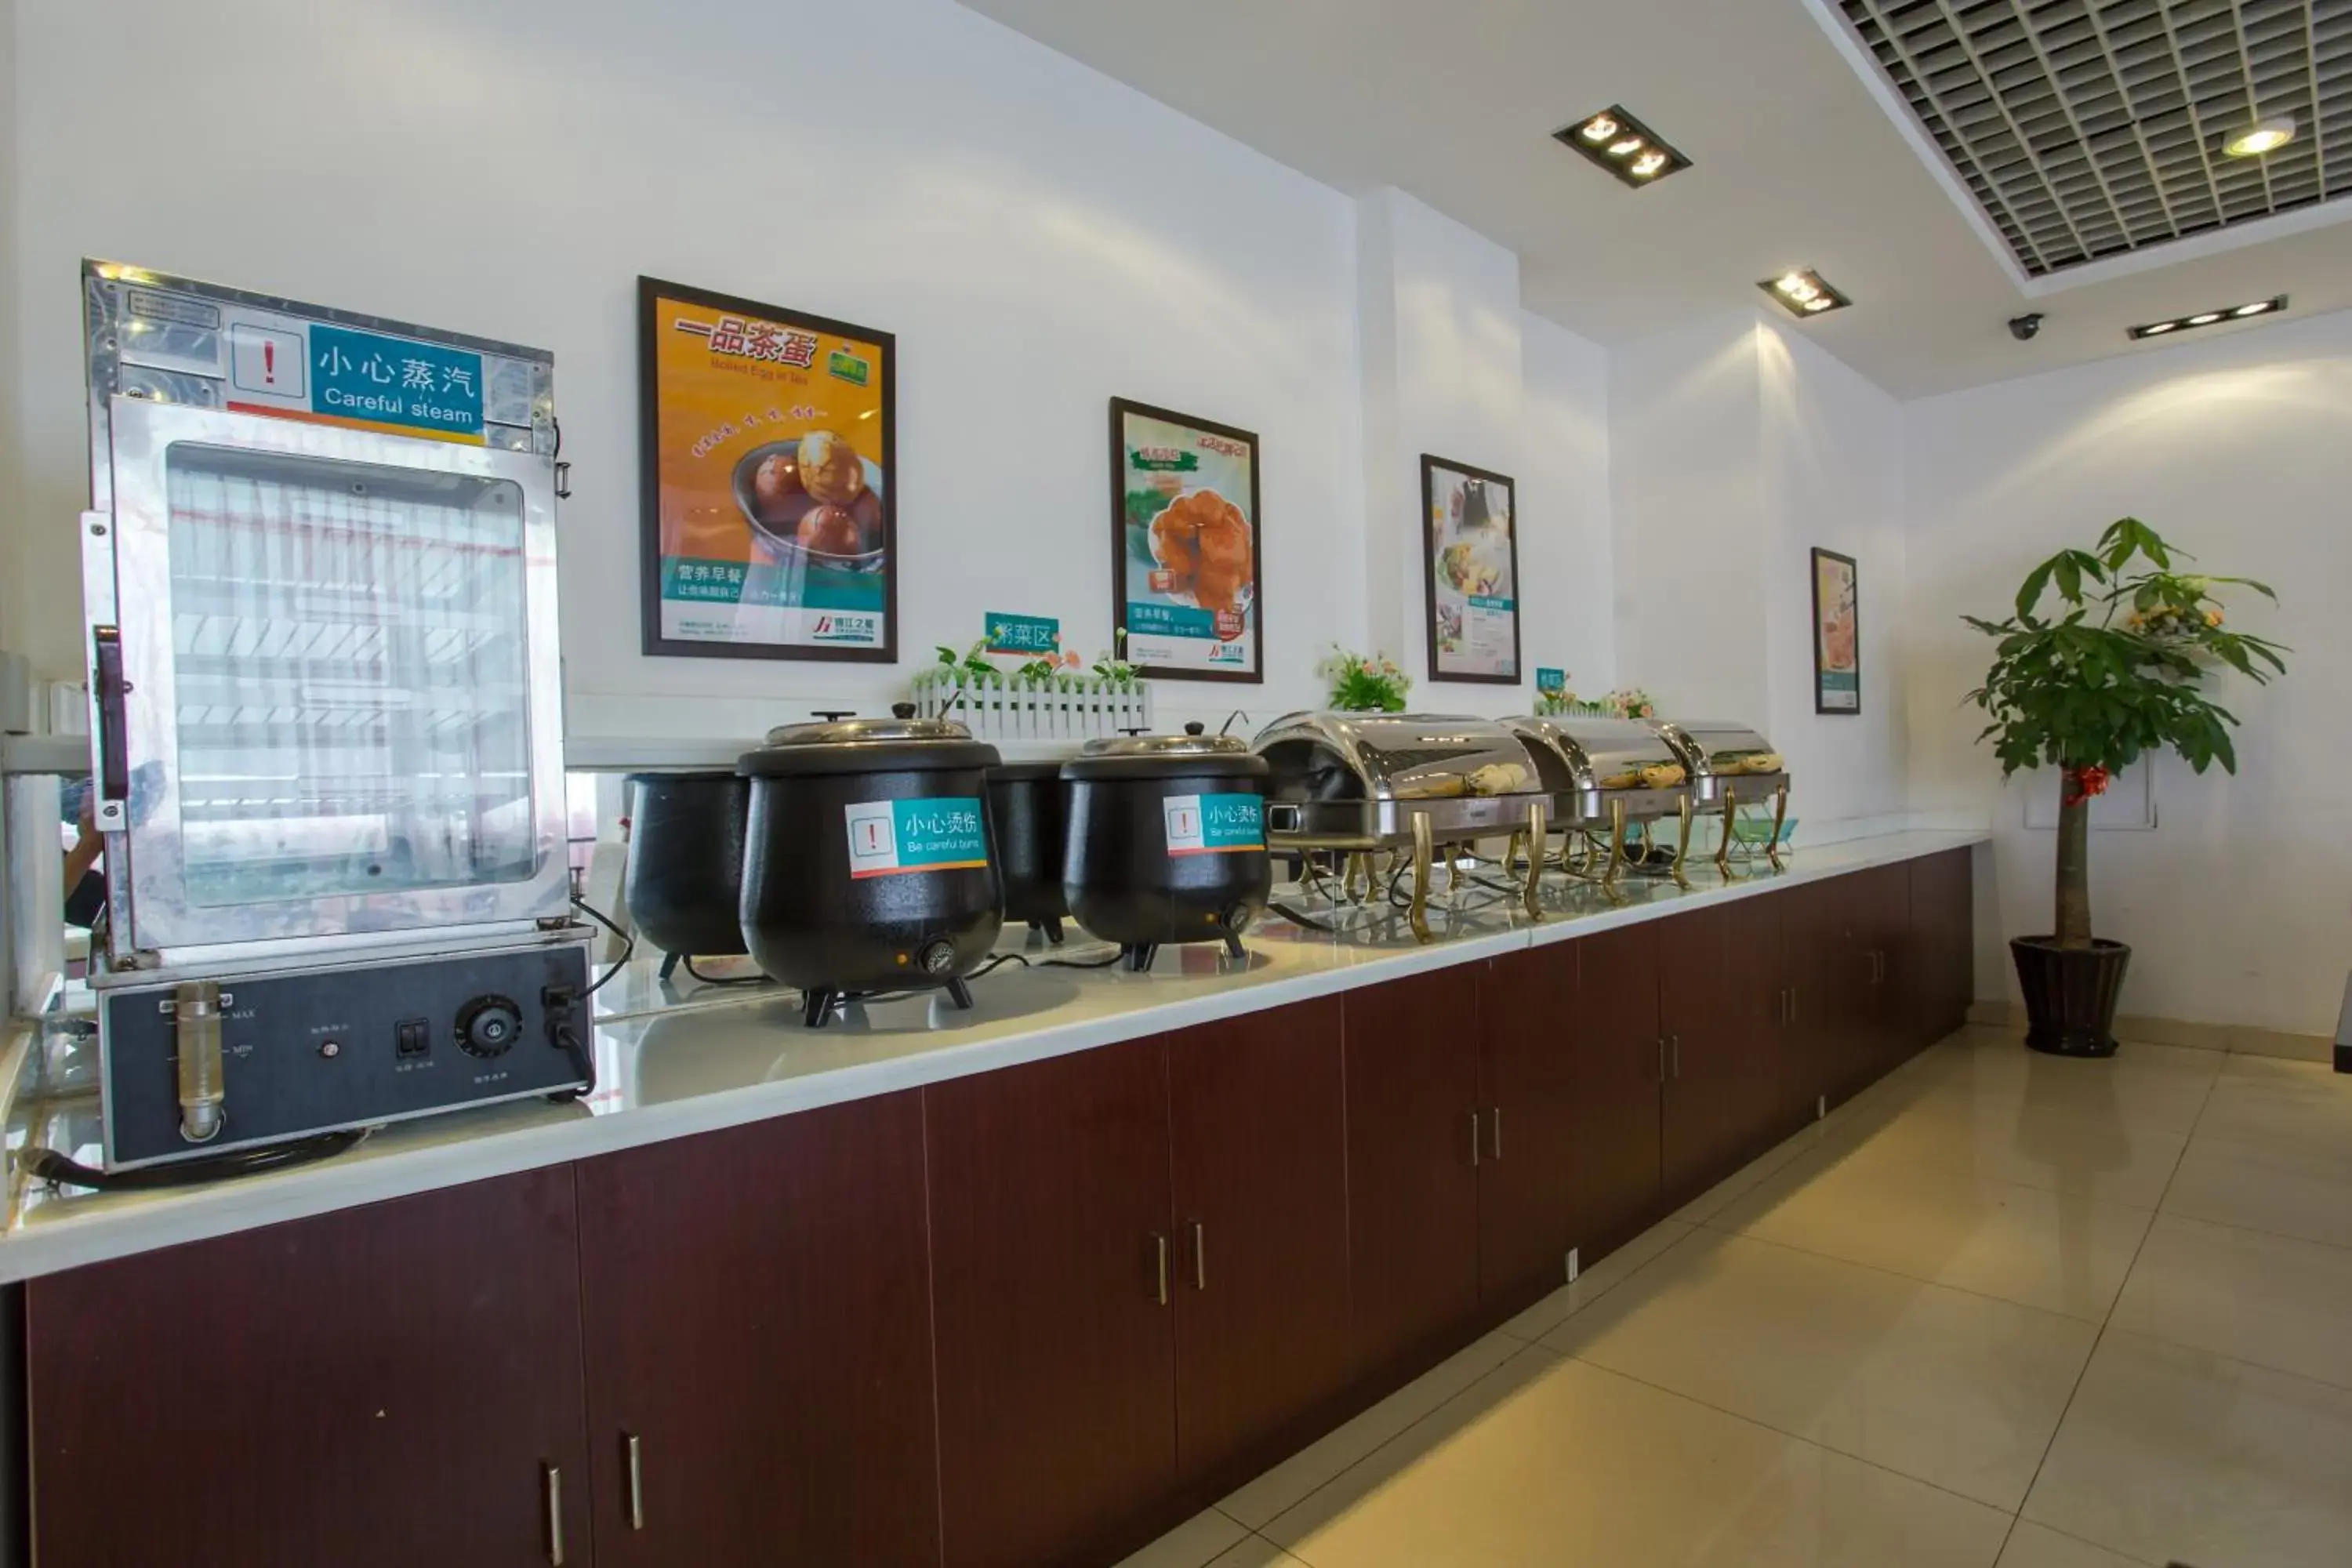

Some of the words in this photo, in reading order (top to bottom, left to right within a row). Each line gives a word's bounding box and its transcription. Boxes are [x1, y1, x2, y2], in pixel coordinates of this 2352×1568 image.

[675, 317, 817, 367] 一品茶蛋
[320, 346, 475, 397] 小心蒸汽
[325, 388, 402, 413] Careful
[412, 401, 472, 423] steam
[677, 564, 742, 583] 营养早餐
[906, 811, 978, 837] 小心烫伤
[907, 841, 923, 853] Be
[232, 1008, 256, 1019] MAX
